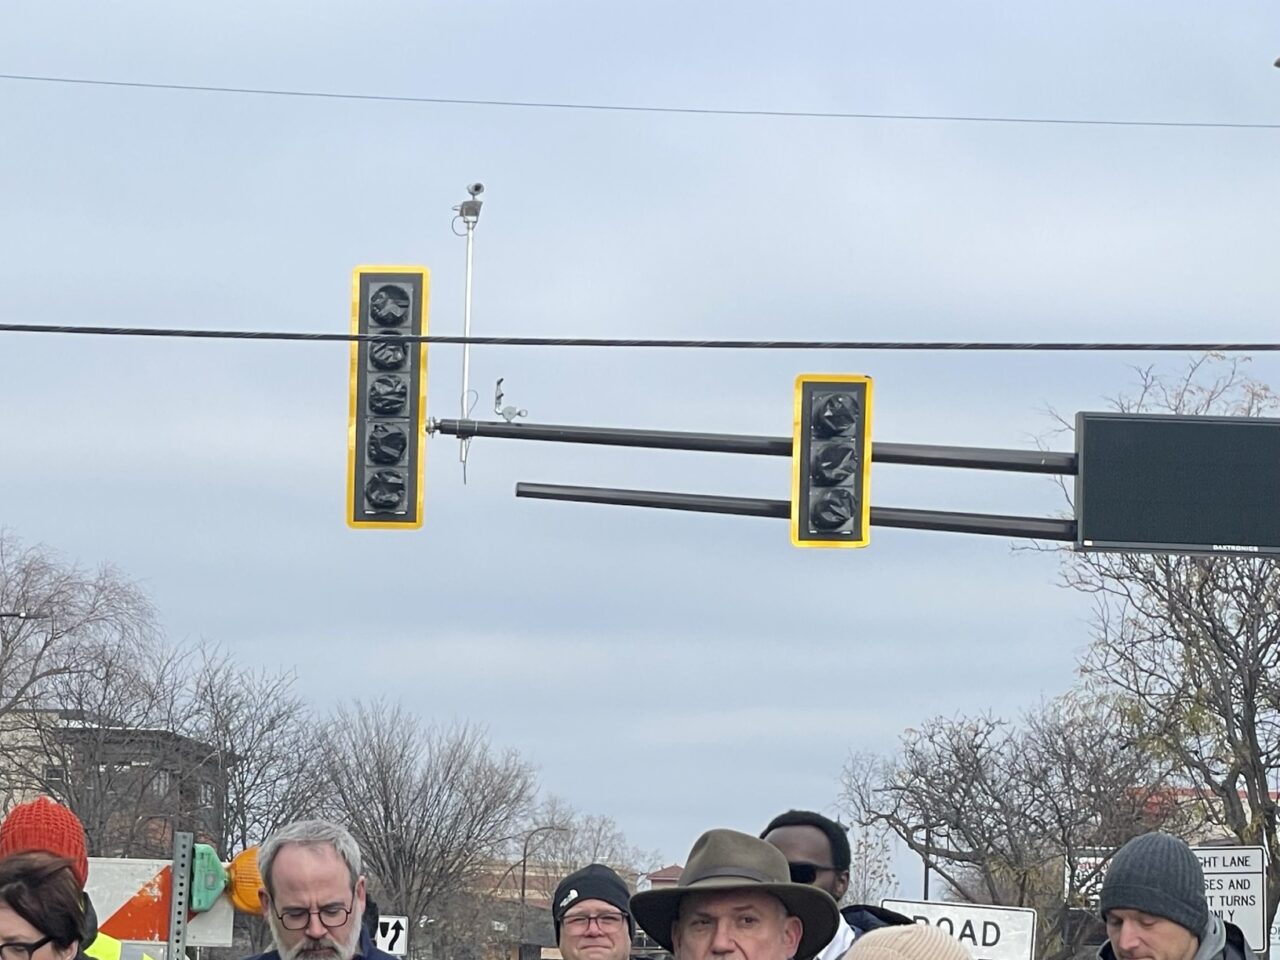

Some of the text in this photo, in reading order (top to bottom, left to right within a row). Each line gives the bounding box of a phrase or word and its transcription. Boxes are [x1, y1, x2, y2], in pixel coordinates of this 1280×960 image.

[1222, 855, 1251, 867] LANE
[1228, 879, 1251, 890] AND
[1219, 894, 1256, 907] TURNS
